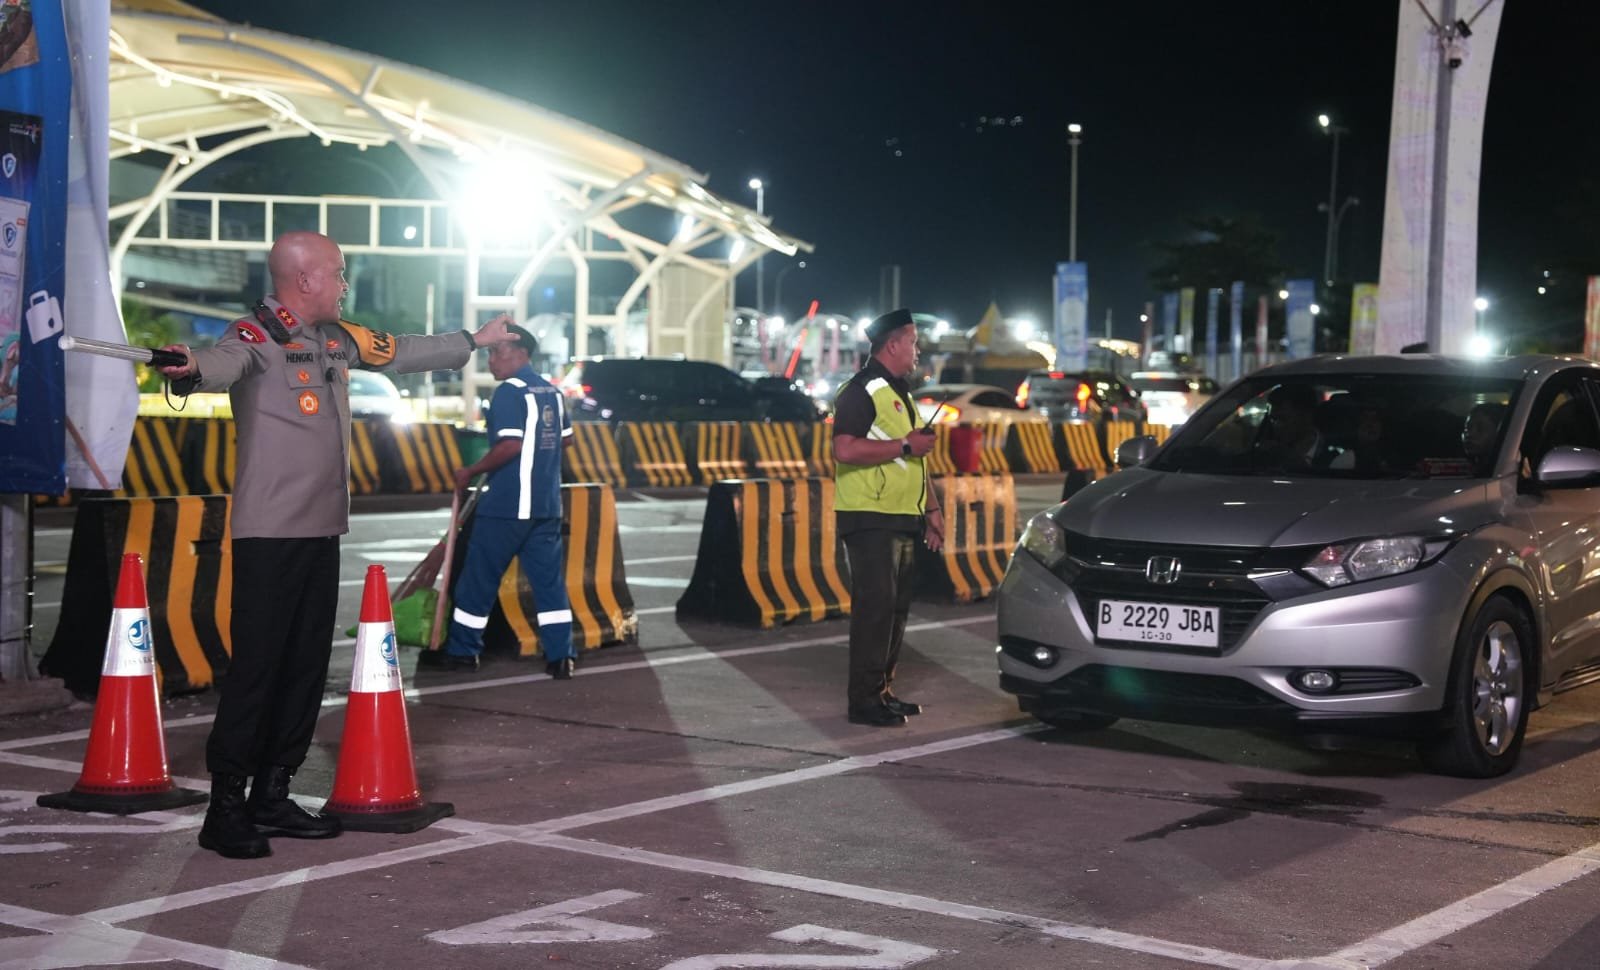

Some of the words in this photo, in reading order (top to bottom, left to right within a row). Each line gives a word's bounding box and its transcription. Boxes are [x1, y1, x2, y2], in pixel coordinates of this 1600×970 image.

[286, 352, 314, 363] HENGKI
[1101, 603, 1112, 625] B
[1123, 604, 1170, 629] 2229
[1178, 608, 1215, 633] JBA
